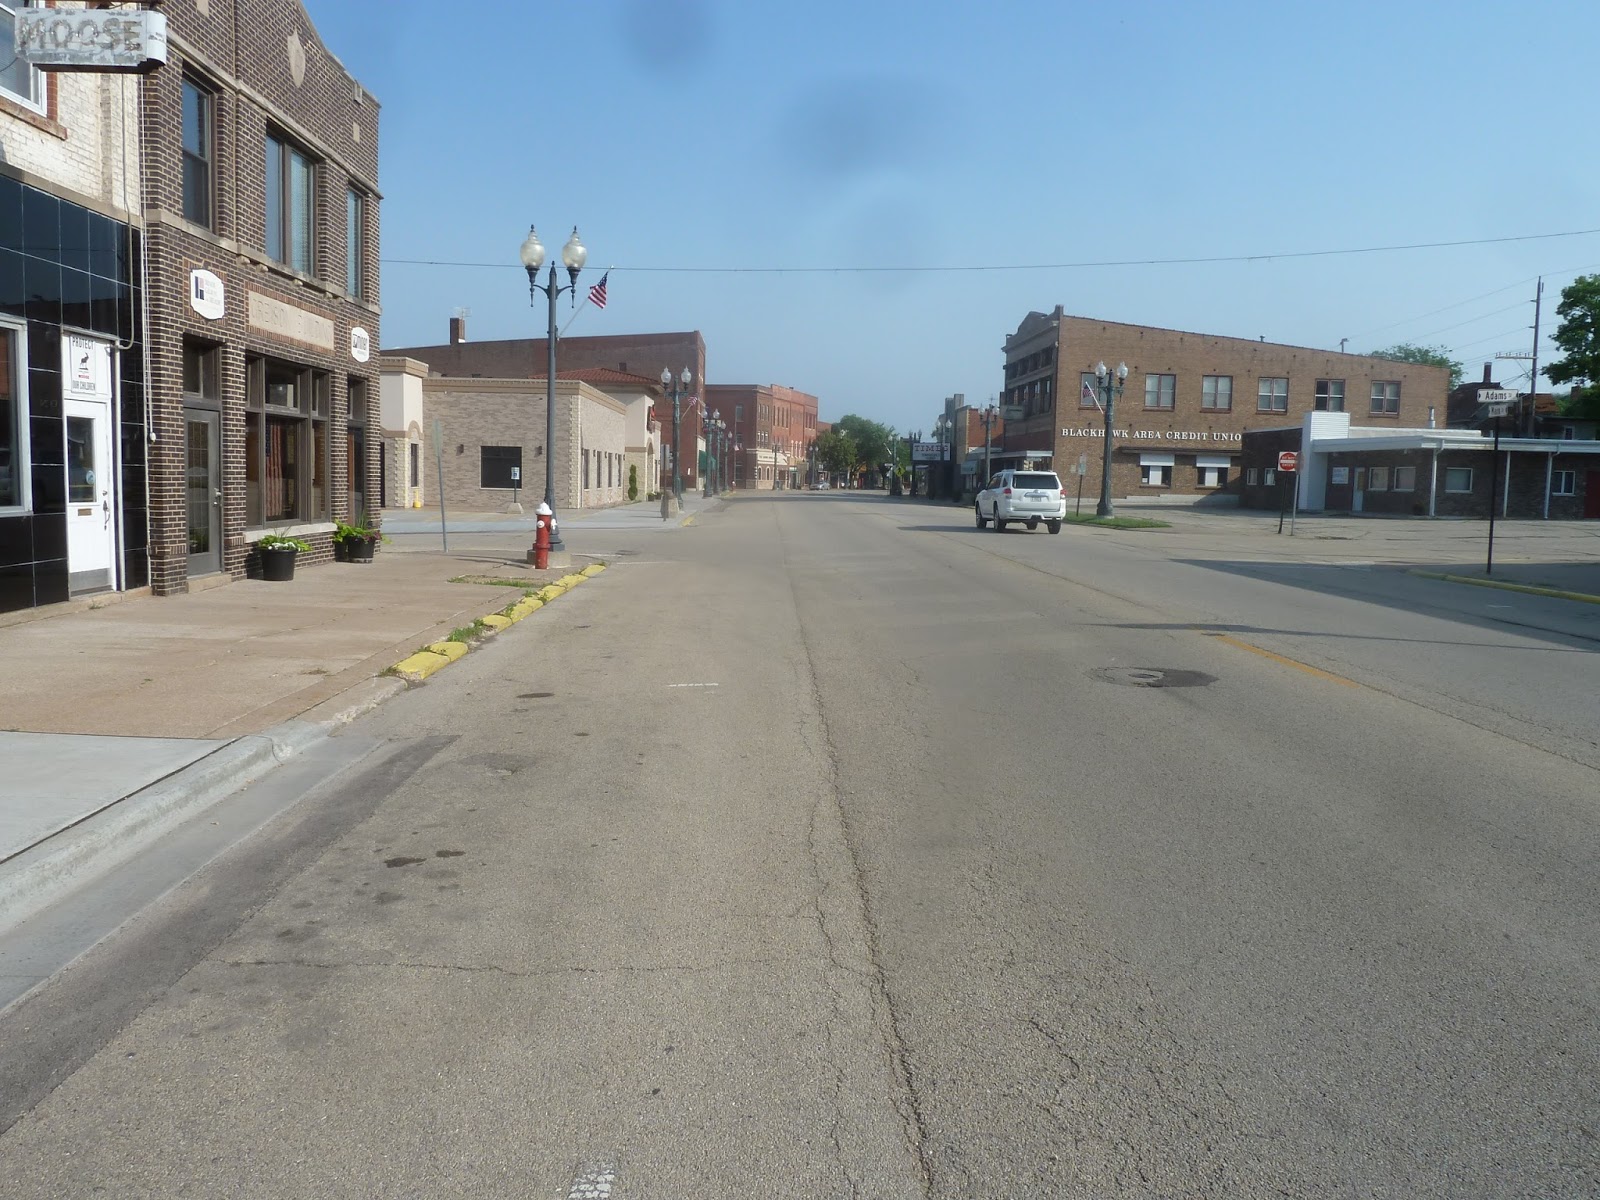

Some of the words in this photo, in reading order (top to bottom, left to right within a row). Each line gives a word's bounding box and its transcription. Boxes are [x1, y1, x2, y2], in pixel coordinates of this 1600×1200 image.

[19, 17, 143, 51] MOOSE
[72, 336, 94, 350] PROTECT
[1485, 391, 1507, 400] Adams
[1062, 428, 1129, 438] BLACKHWK
[1133, 430, 1161, 439] AREA
[1166, 431, 1209, 441] CREDIT
[1213, 432, 1242, 442] UNIO
